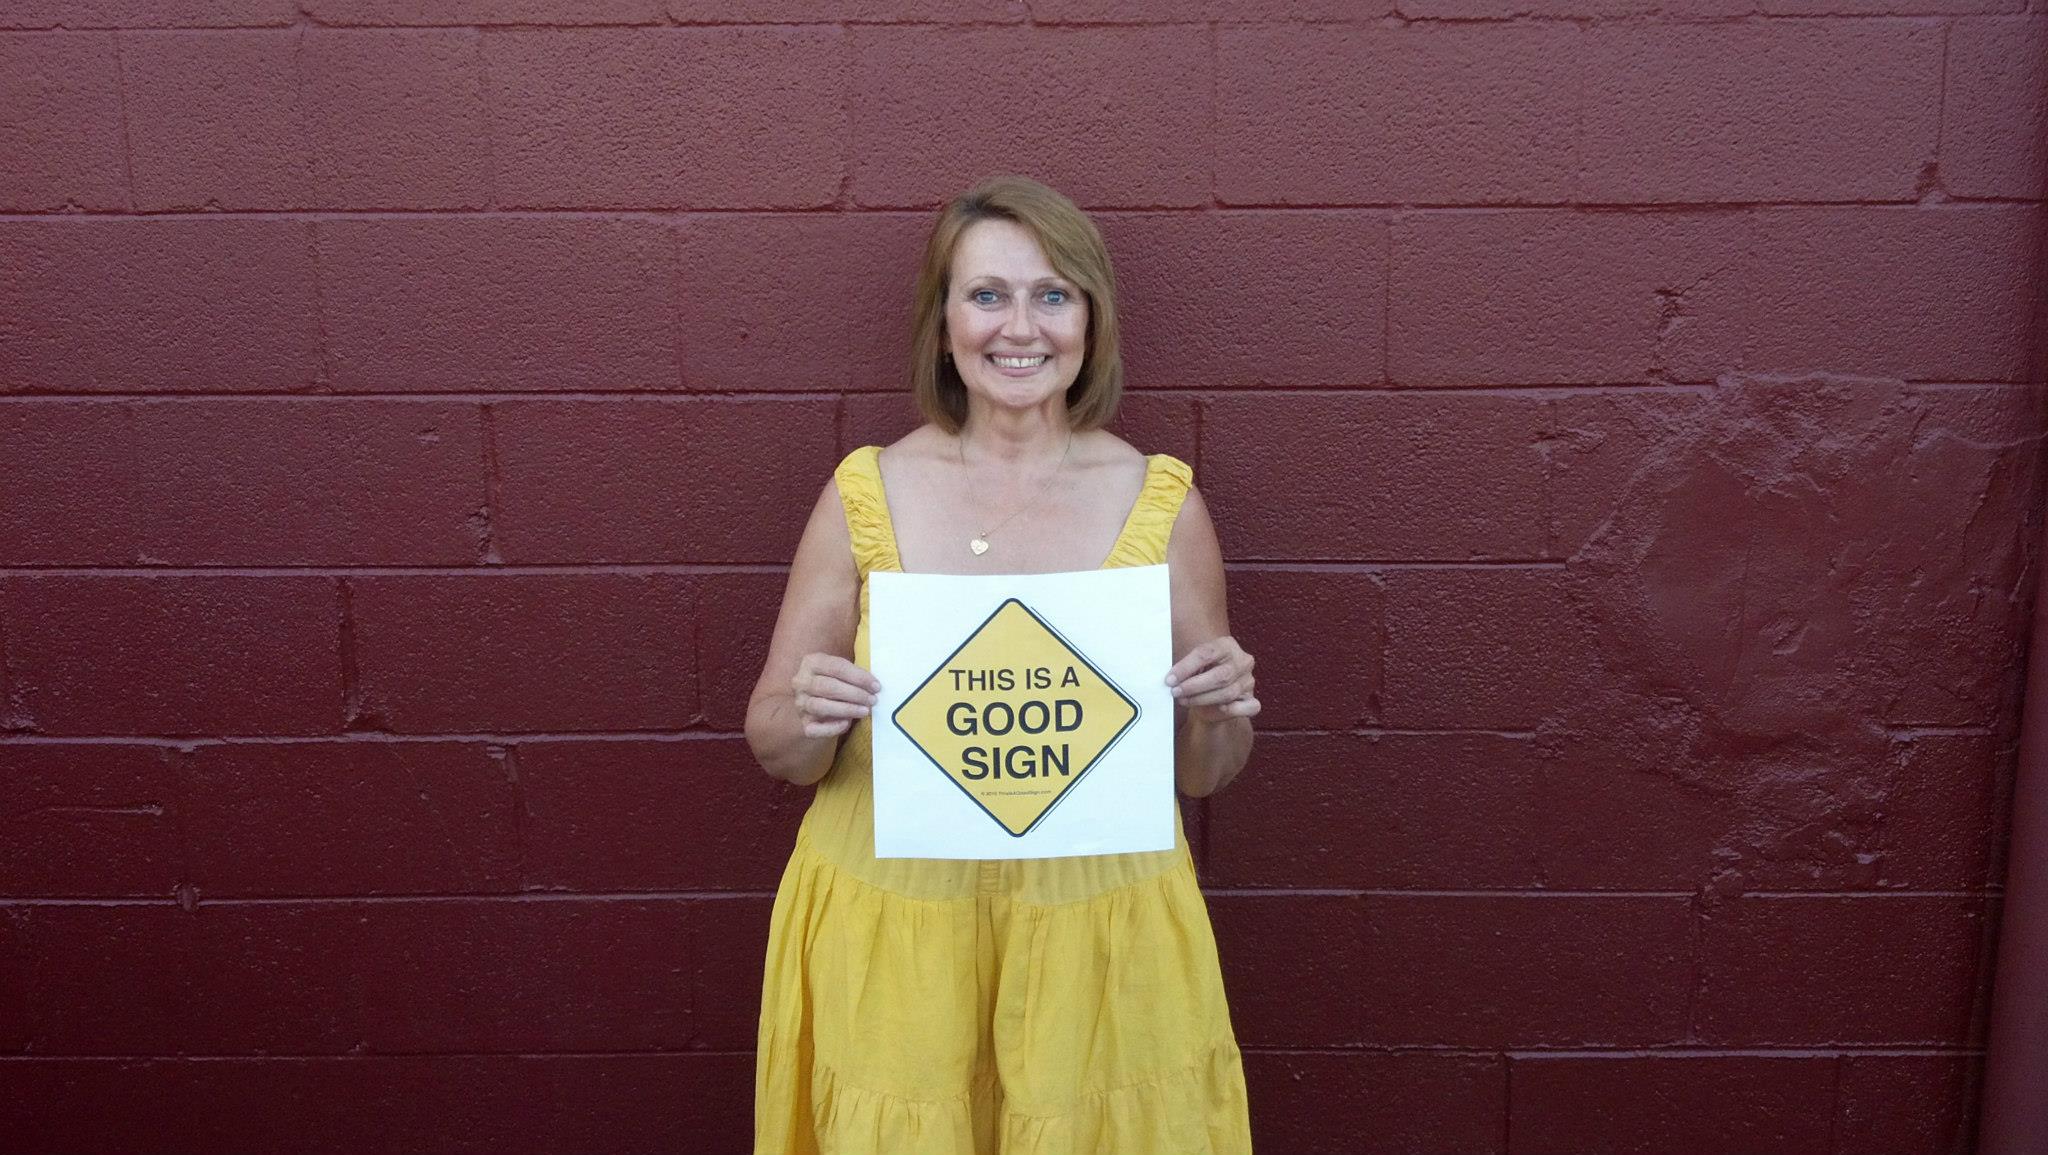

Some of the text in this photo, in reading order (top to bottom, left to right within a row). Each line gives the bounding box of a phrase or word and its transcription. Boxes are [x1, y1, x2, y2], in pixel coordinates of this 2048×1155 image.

[948, 666, 1080, 691] THIS IS A
[946, 699, 1083, 736] GOOD
[962, 743, 1070, 780] SIGN
